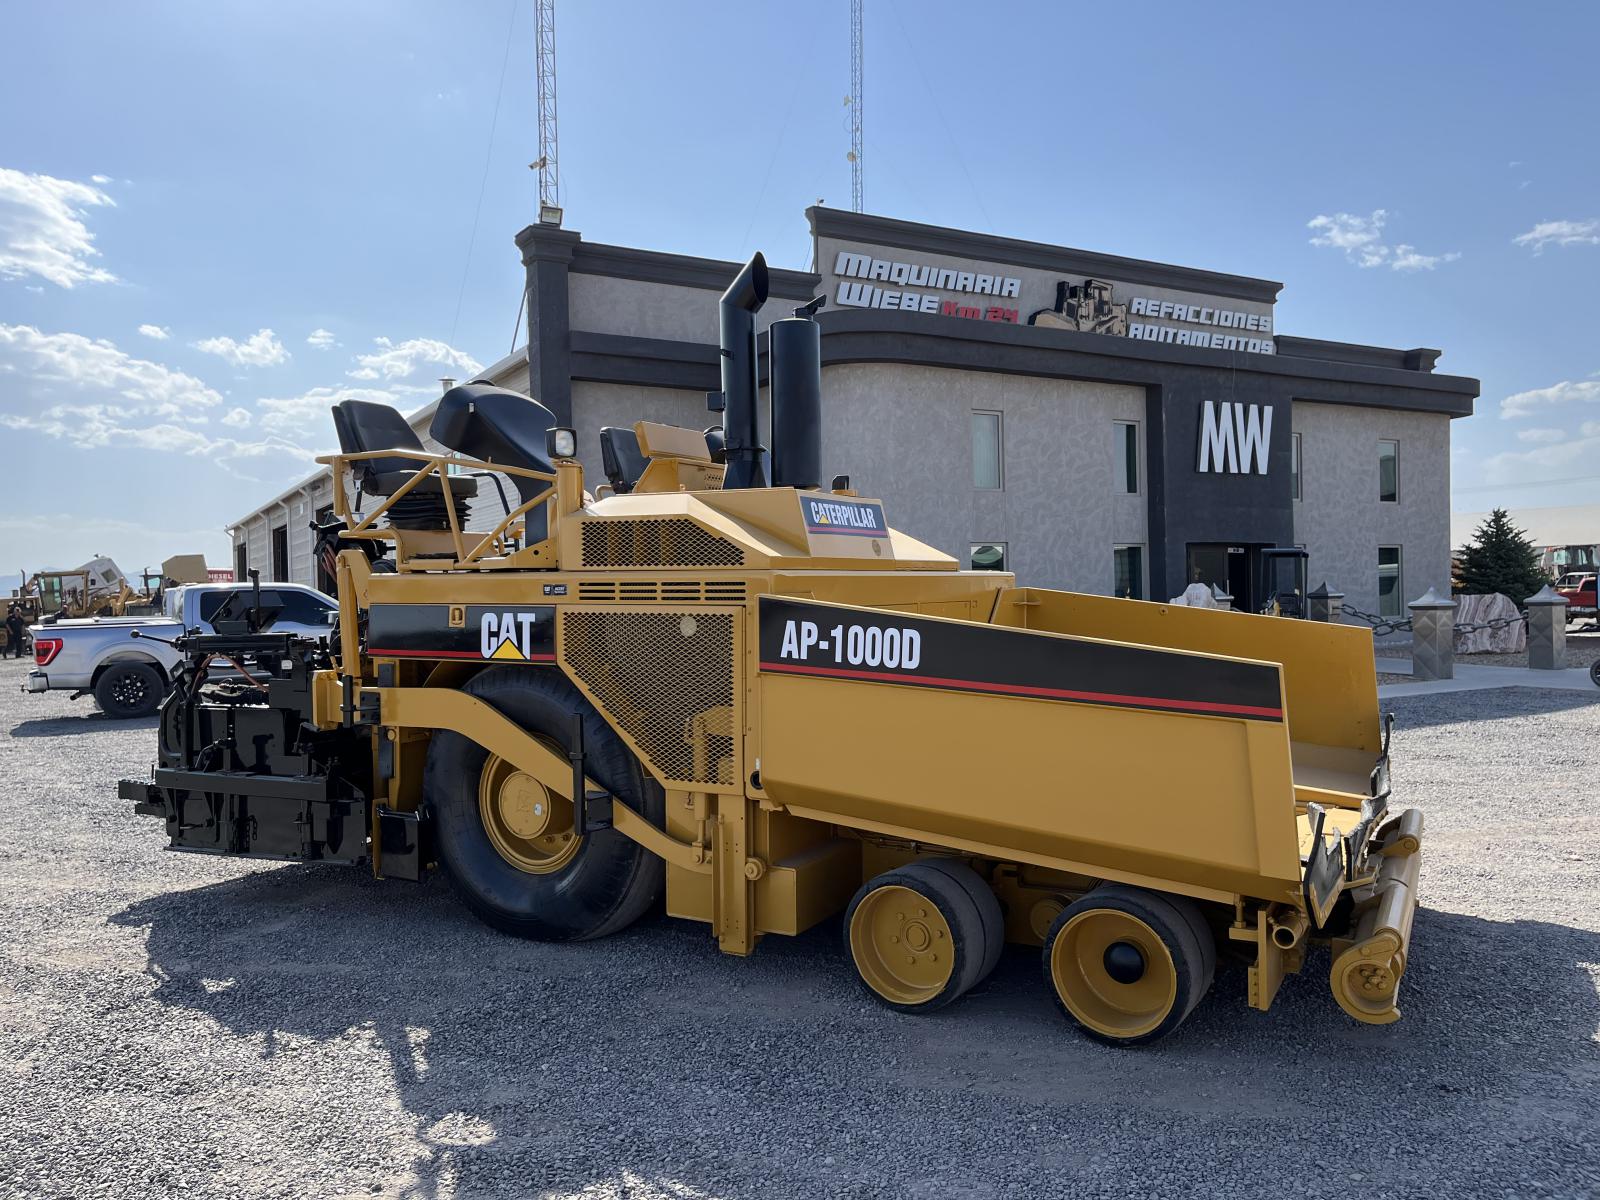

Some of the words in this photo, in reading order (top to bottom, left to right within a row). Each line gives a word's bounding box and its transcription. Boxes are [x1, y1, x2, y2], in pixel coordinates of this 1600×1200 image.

[834, 252, 1021, 298] MAQUINARIA
[837, 281, 940, 313] WIEBE
[1131, 297, 1272, 332] REFACCIONES
[1128, 322, 1274, 355] ADITAMENTOS
[1199, 400, 1273, 475] MW
[810, 501, 877, 529] CATERPILLAR
[480, 612, 536, 660] CAT
[780, 620, 921, 670] AP-1000D
